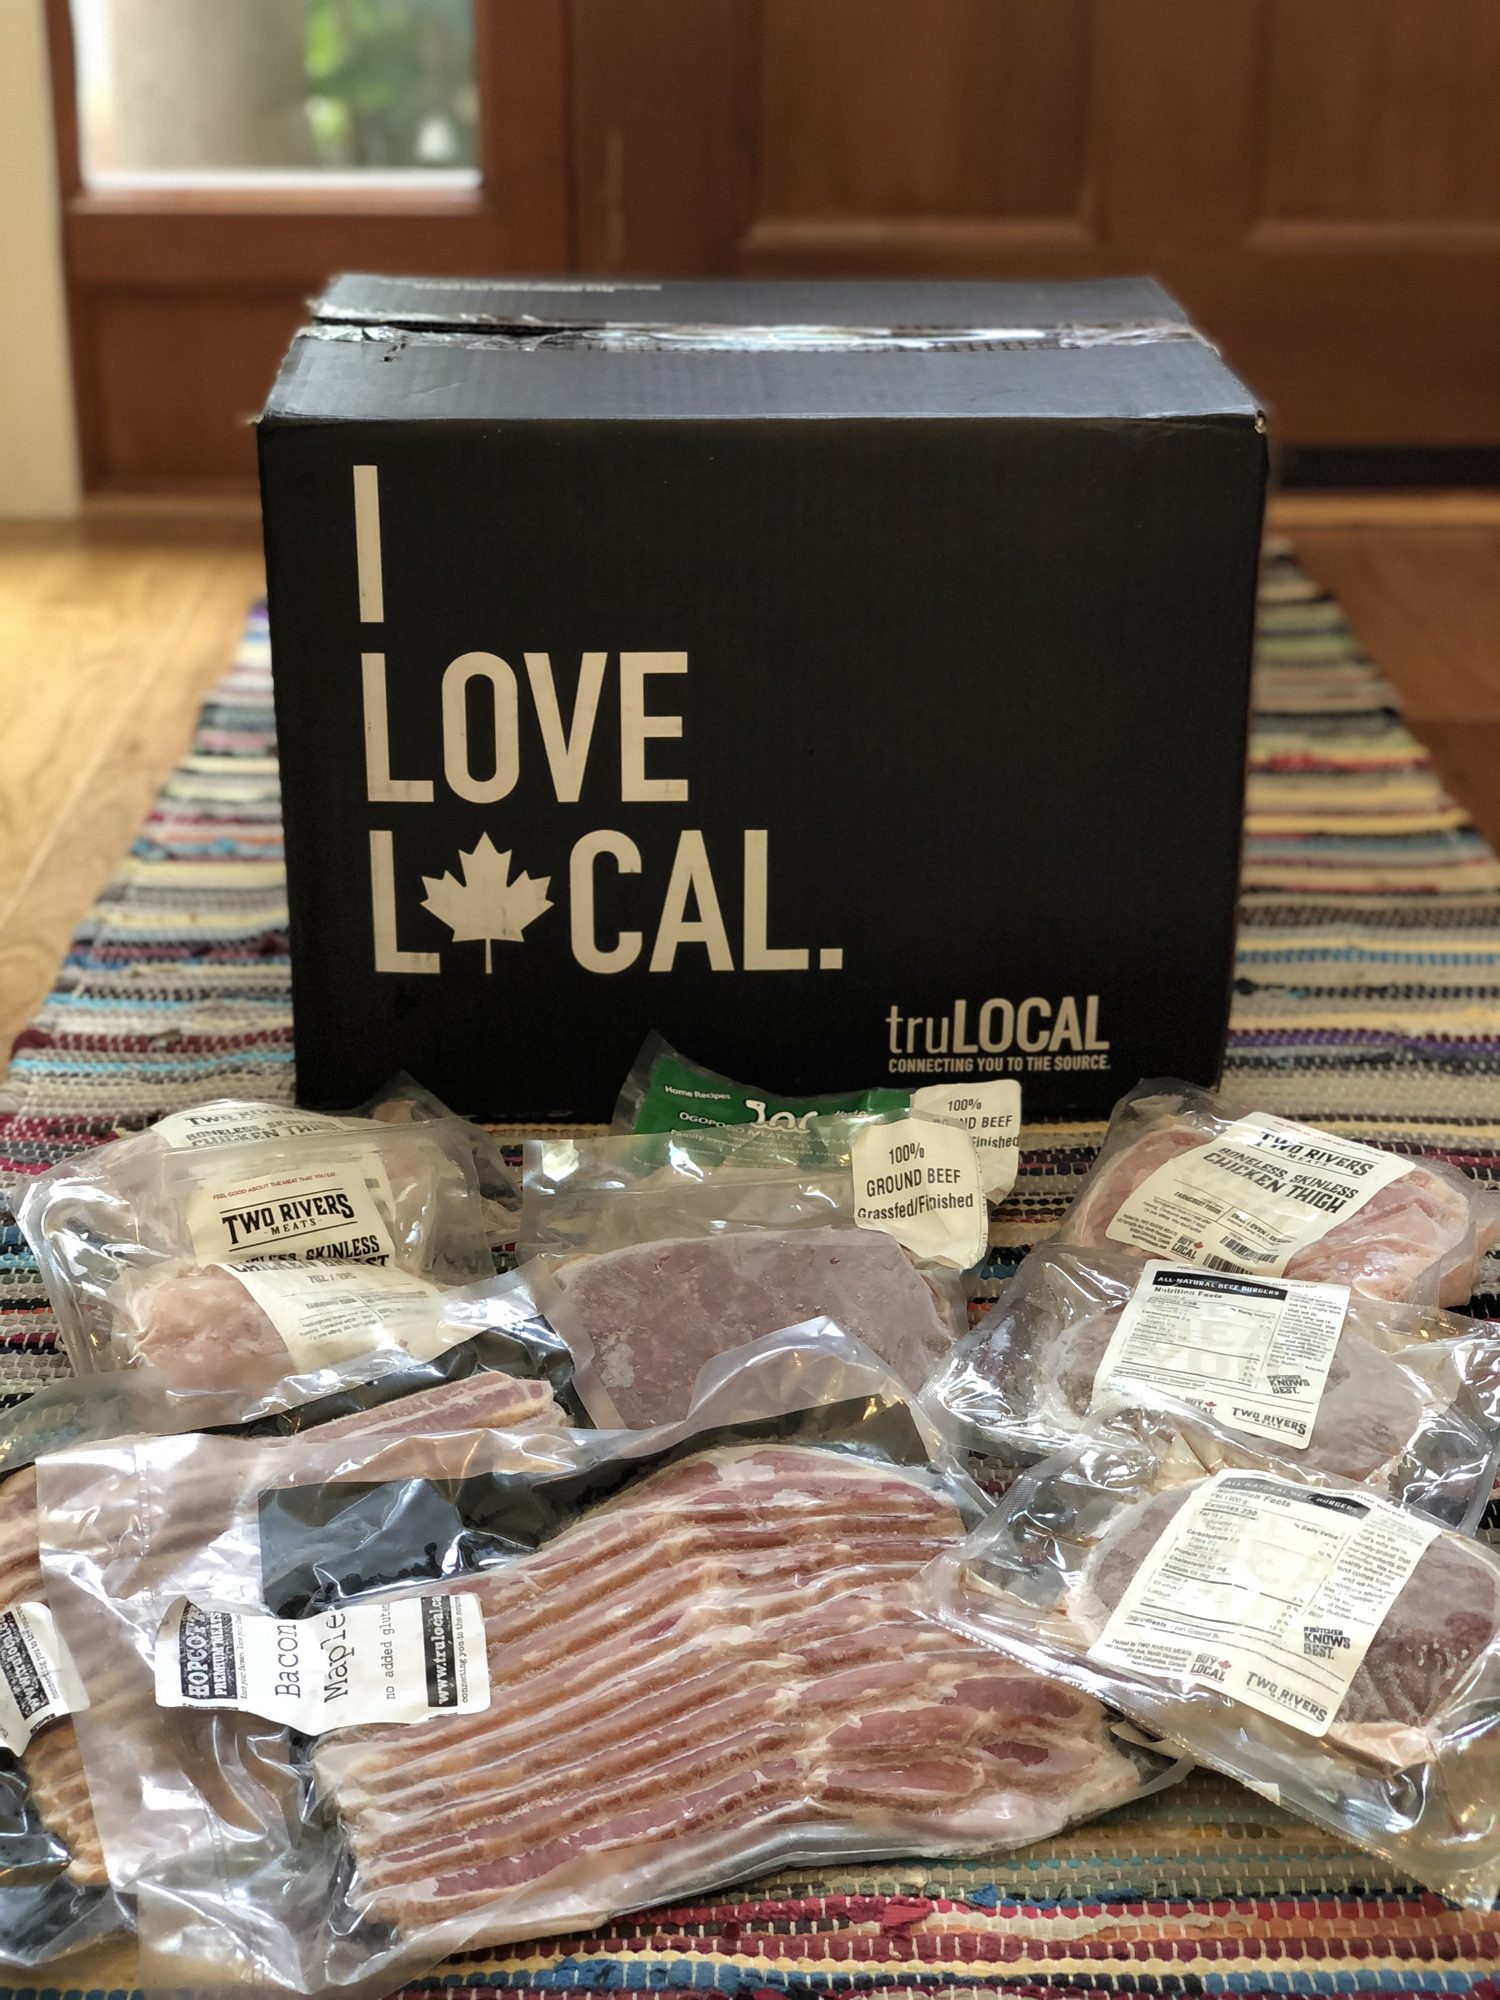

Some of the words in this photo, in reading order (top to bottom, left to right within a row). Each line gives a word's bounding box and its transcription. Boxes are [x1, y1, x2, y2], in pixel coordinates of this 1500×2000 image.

[353, 465, 384, 623] I
[361, 652, 689, 804] LOVE
[886, 995, 1110, 1054] truLOCAL
[889, 1057, 974, 1073] CONNECTING
[977, 1057, 1004, 1072] YOU
[1007, 1056, 1024, 1072] TO
[1027, 1055, 1051, 1072] THE
[1054, 1054, 1110, 1071] SOURCE.
[665, 1085, 693, 1098] Home
[694, 1090, 731, 1101] Recipes
[948, 1098, 982, 1112] 100%
[981, 1115, 1013, 1128] BEEF
[889, 1142, 925, 1165] 100%
[1305, 1149, 1374, 1178] RIVERS
[866, 1168, 922, 1197] GROUND
[927, 1168, 961, 1184] BEEF
[1202, 1152, 1286, 1194] CHICKEN
[1285, 1184, 1348, 1214] THIGH
[1218, 1147, 1288, 1180] BONELESS,
[1289, 1174, 1359, 1199] SKINLESS
[228, 1188, 247, 1198] GOOD
[248, 1183, 269, 1194] ABOUT
[222, 1207, 275, 1245] TWO
[279, 1193, 355, 1222] RIVERS
[857, 1193, 974, 1220] Grassfed/Finished
[271, 1218, 317, 1236] MEATS
[305, 1235, 380, 1260] SKINLESS
[1171, 1243, 1198, 1260] LOCAL
[1177, 1236, 1194, 1247] BUY
[1268, 1379, 1310, 1389] KNOWS
[1231, 1407, 1260, 1419] TWO
[1263, 1415, 1307, 1435] RIVERS
[209, 1611, 225, 1645] MEATS
[456, 1616, 465, 1630] the
[457, 1631, 466, 1640] to
[429, 1595, 450, 1705] www.trulocal.ca
[456, 1640, 467, 1658] you
[1303, 1632, 1351, 1650] KNOWS
[1303, 1643, 1335, 1660] BEST.
[275, 1624, 301, 1699] Bacon
[320, 1612, 355, 1704] Maple
[380, 1641, 395, 1678] added
[1195, 1654, 1218, 1666] BUY
[211, 1645, 228, 1697] PREMIUM
[457, 1658, 469, 1703] connecting
[1190, 1663, 1227, 1683] LOCAL
[385, 1686, 396, 1700] no
[1246, 1671, 1279, 1694] TWO
[1279, 1689, 1329, 1724] RIVERS
